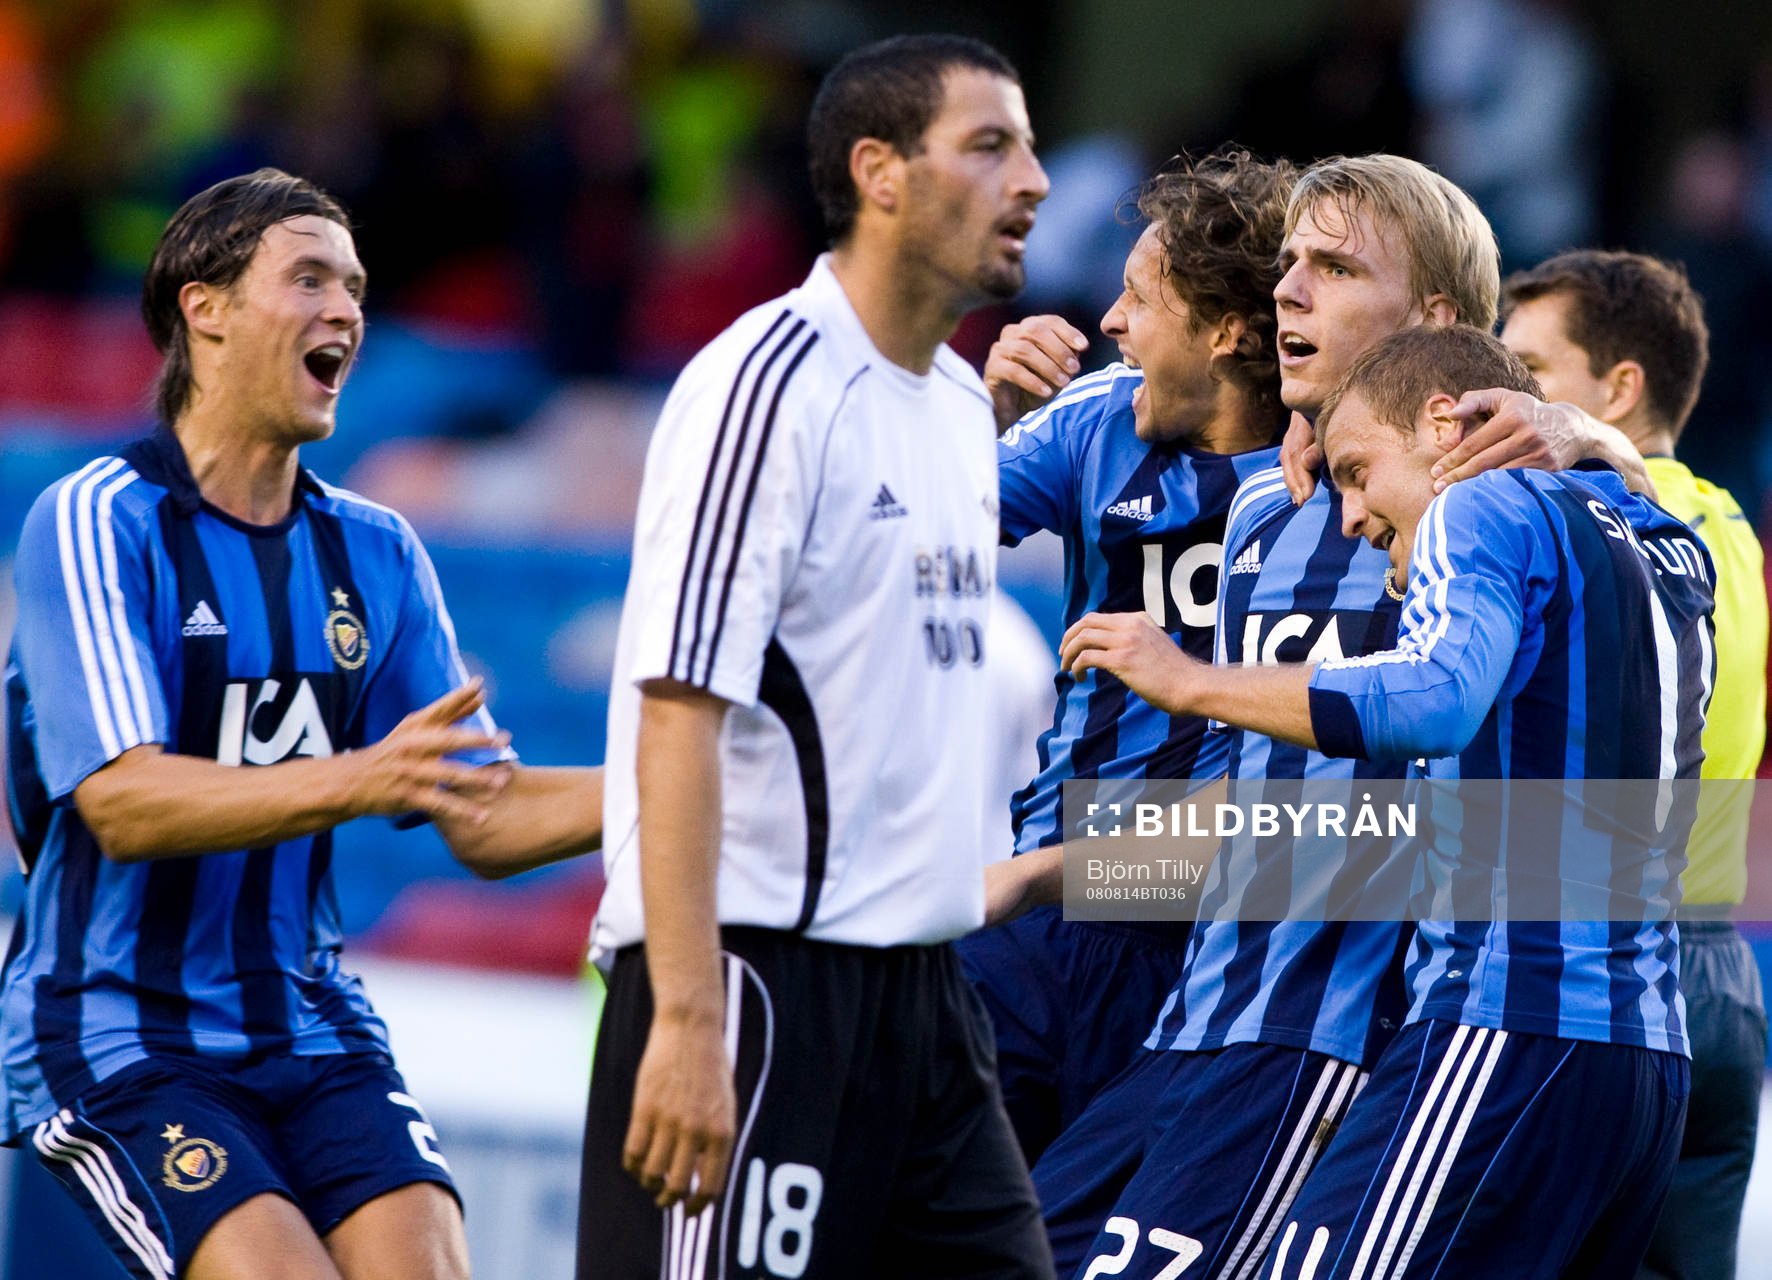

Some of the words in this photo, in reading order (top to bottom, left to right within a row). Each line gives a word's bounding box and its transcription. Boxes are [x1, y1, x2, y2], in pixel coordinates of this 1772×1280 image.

[1107, 505, 1155, 522] adidas
[1142, 542, 1225, 628] IC
[217, 677, 334, 767] ICA
[737, 1157, 824, 1279] 18
